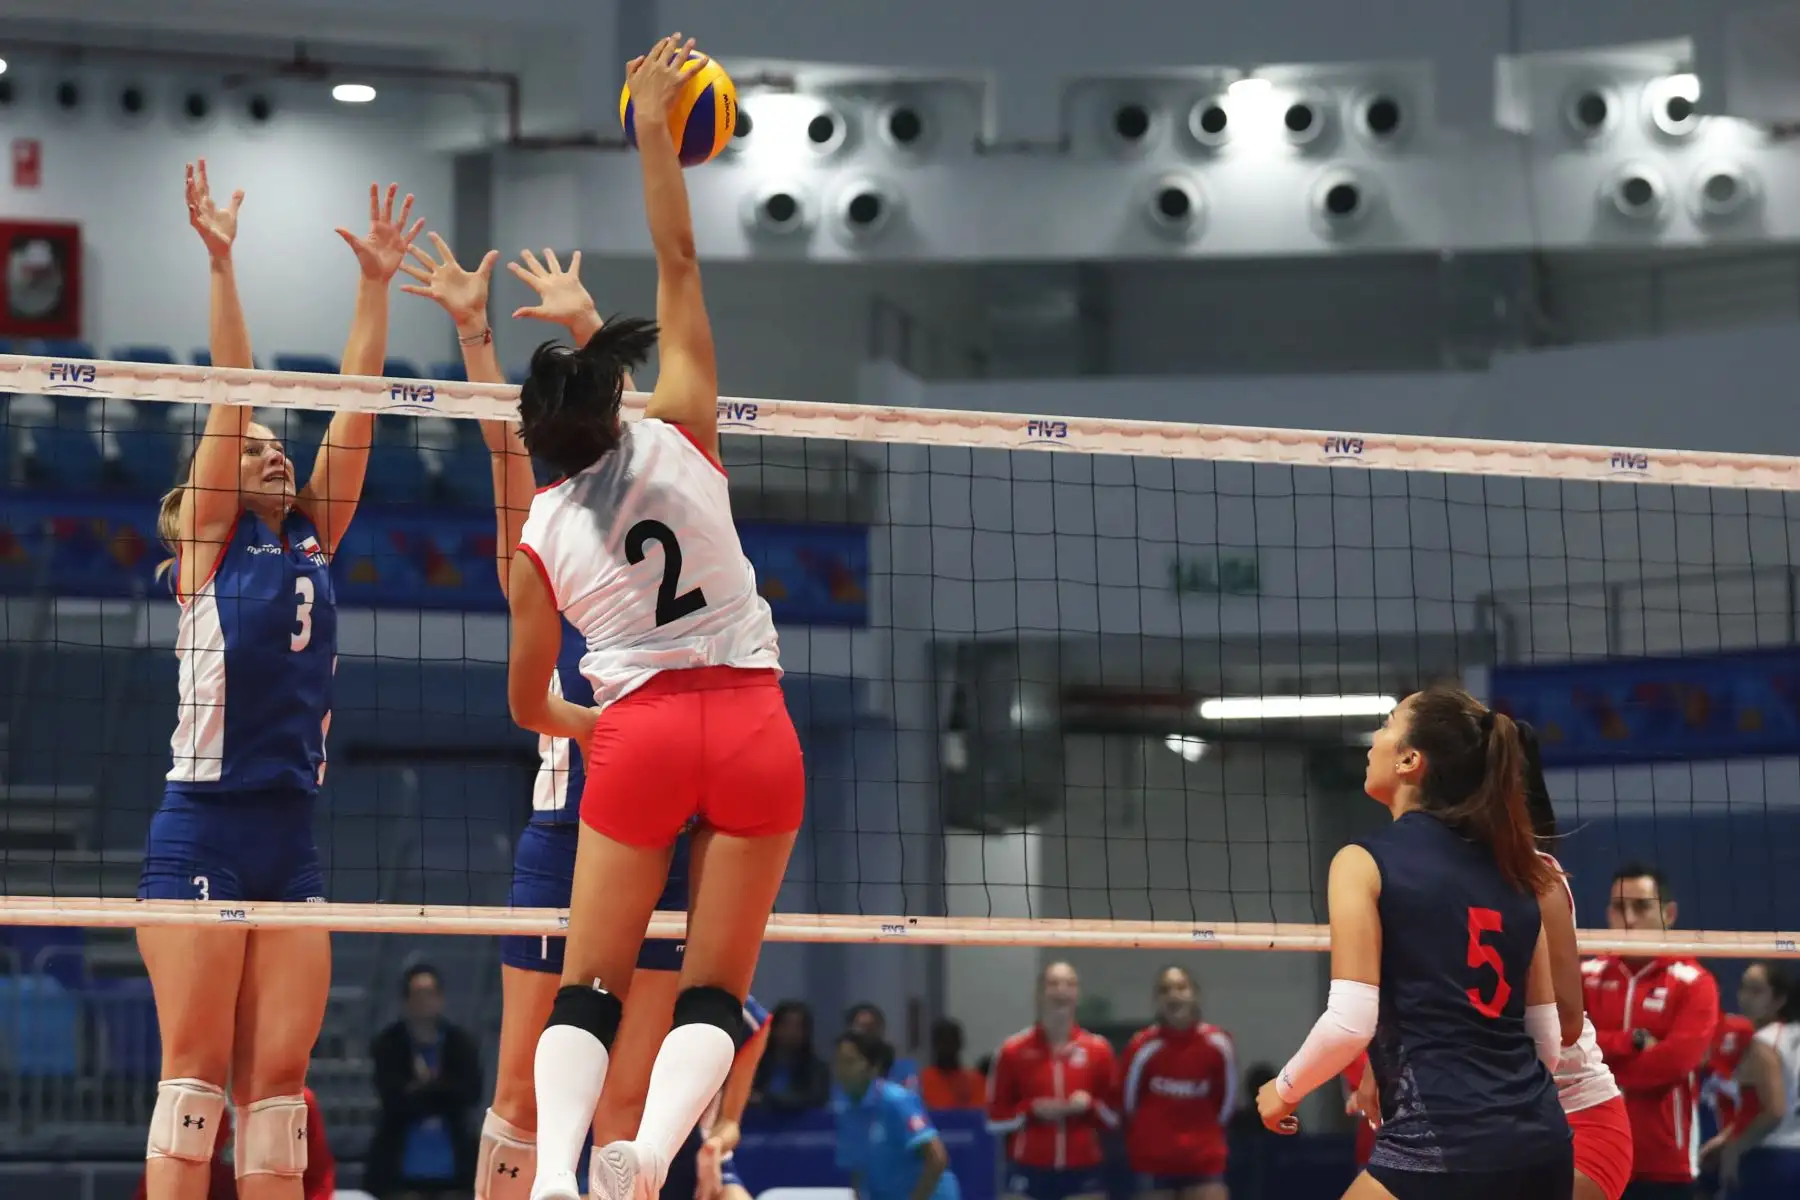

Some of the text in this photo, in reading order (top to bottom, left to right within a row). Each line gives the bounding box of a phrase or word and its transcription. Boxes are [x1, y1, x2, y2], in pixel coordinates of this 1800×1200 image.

[290, 576, 315, 653] 3
[625, 519, 708, 628] 2
[192, 875, 210, 901] 3
[1466, 906, 1512, 1018] 5
